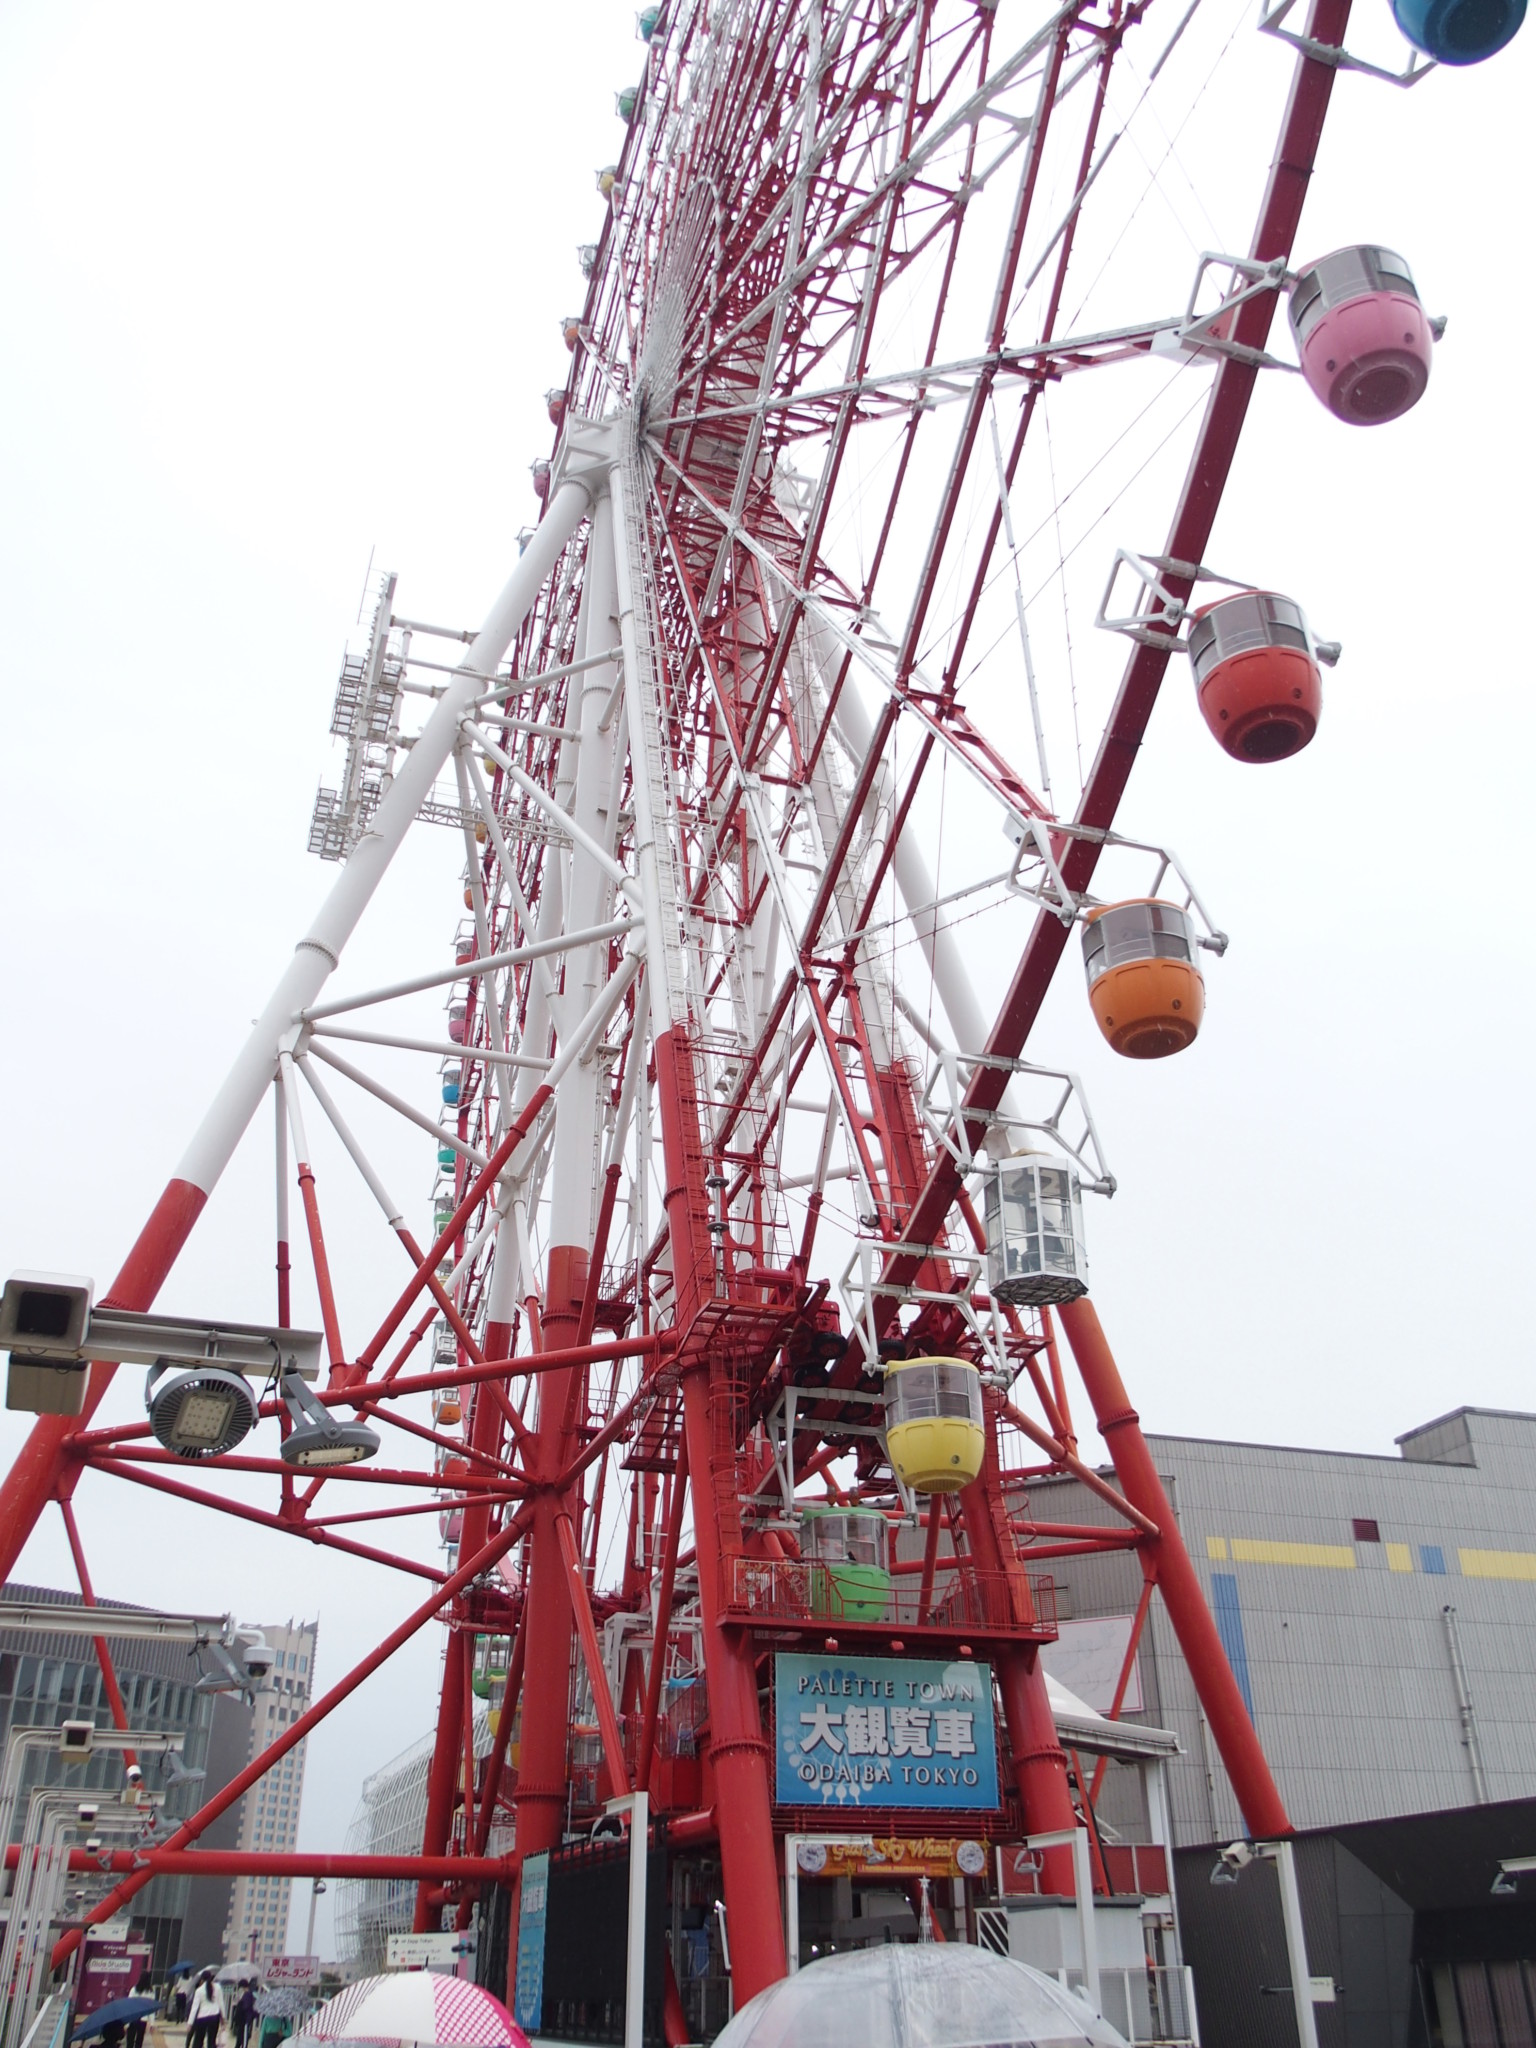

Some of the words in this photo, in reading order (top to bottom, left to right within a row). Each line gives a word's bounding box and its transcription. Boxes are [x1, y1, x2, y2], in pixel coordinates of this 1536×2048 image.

[798, 1676, 894, 1698] PALETTE
[906, 1681, 974, 1701] TOWN
[800, 1703, 976, 1759] 大観覧車
[800, 1763, 892, 1784] ODAIBA
[902, 1766, 979, 1785] TOKYO
[907, 1838, 956, 1858] Wheel
